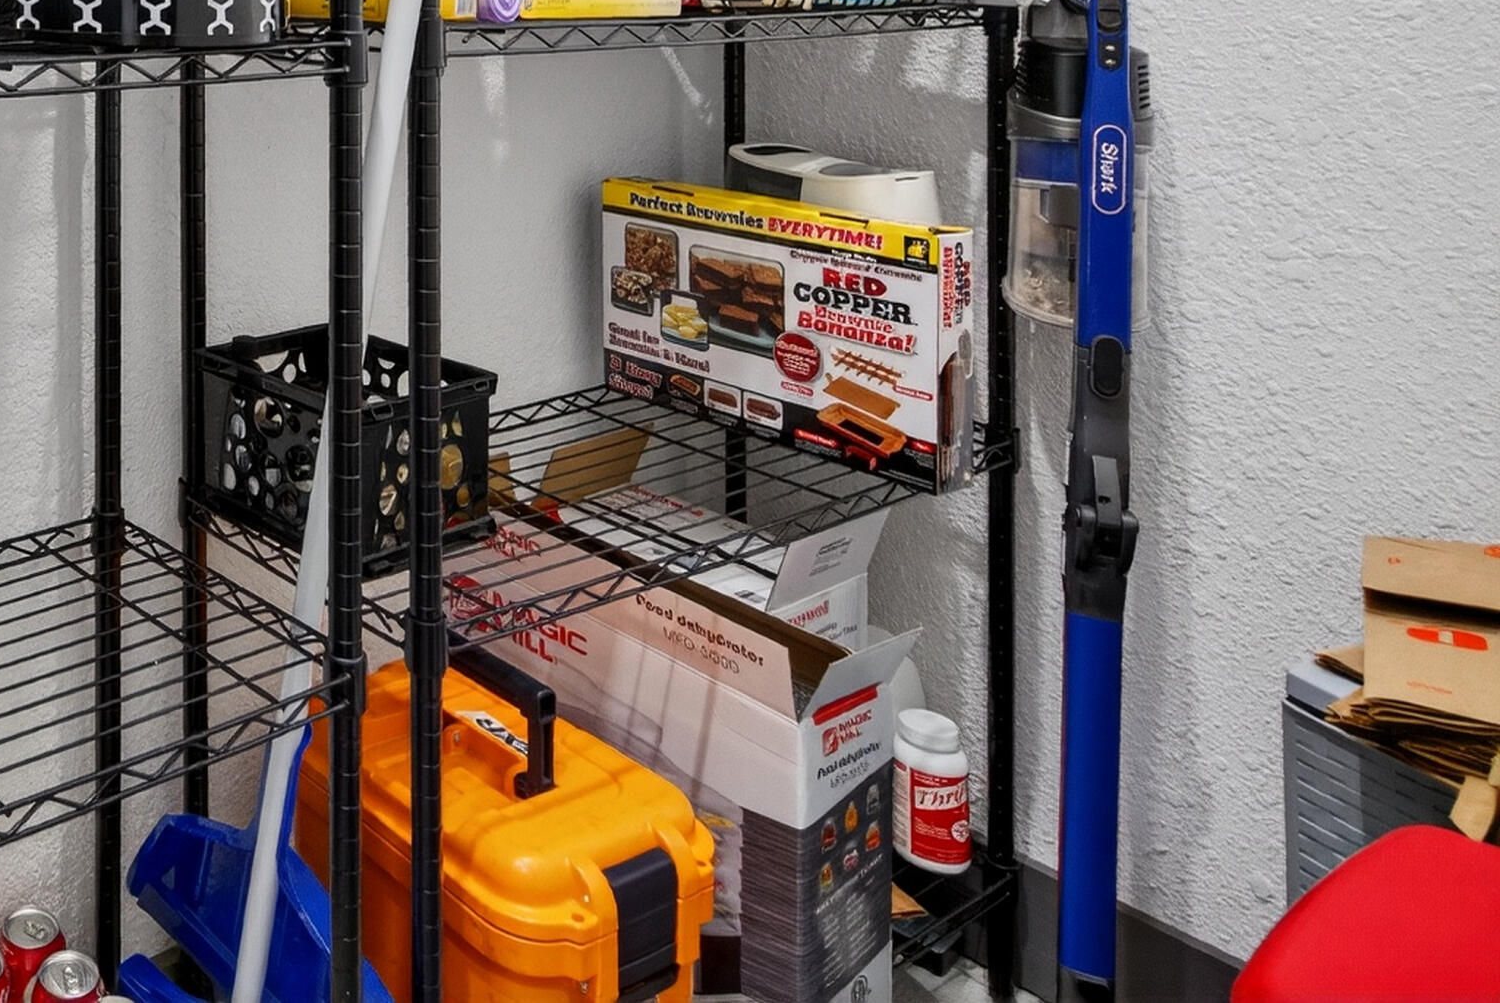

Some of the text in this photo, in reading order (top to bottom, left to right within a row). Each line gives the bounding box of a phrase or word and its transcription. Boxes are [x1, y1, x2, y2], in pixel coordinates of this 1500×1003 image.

[1100, 142, 1119, 195] Shark
[629, 192, 884, 250] Perfect Brownies EVERYTIME!
[793, 282, 913, 326] COPPER
[822, 267, 888, 297] RED
[797, 311, 915, 353] Bonanza!
